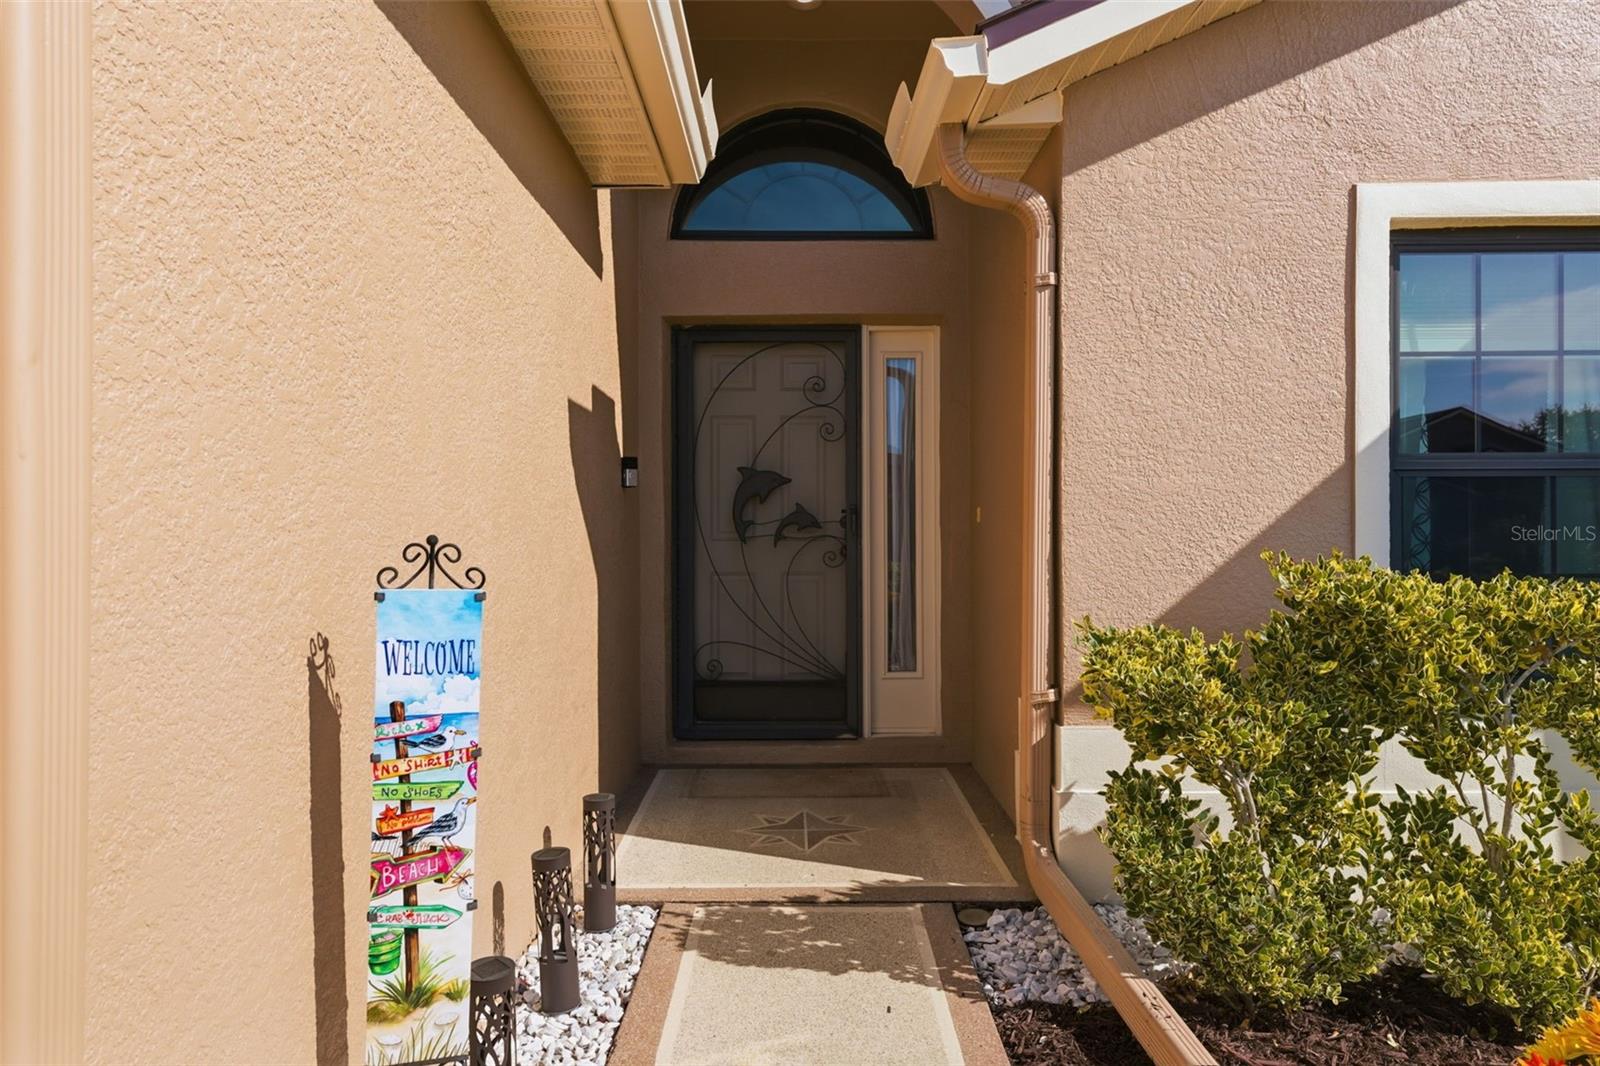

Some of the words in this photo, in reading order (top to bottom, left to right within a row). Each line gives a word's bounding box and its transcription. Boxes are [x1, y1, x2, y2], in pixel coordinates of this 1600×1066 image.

[382, 639, 476, 676] WELCOME
[380, 764, 399, 776] NO
[381, 787, 399, 797] NO
[403, 786, 442, 799] SHOES
[382, 858, 438, 888] BEACH
